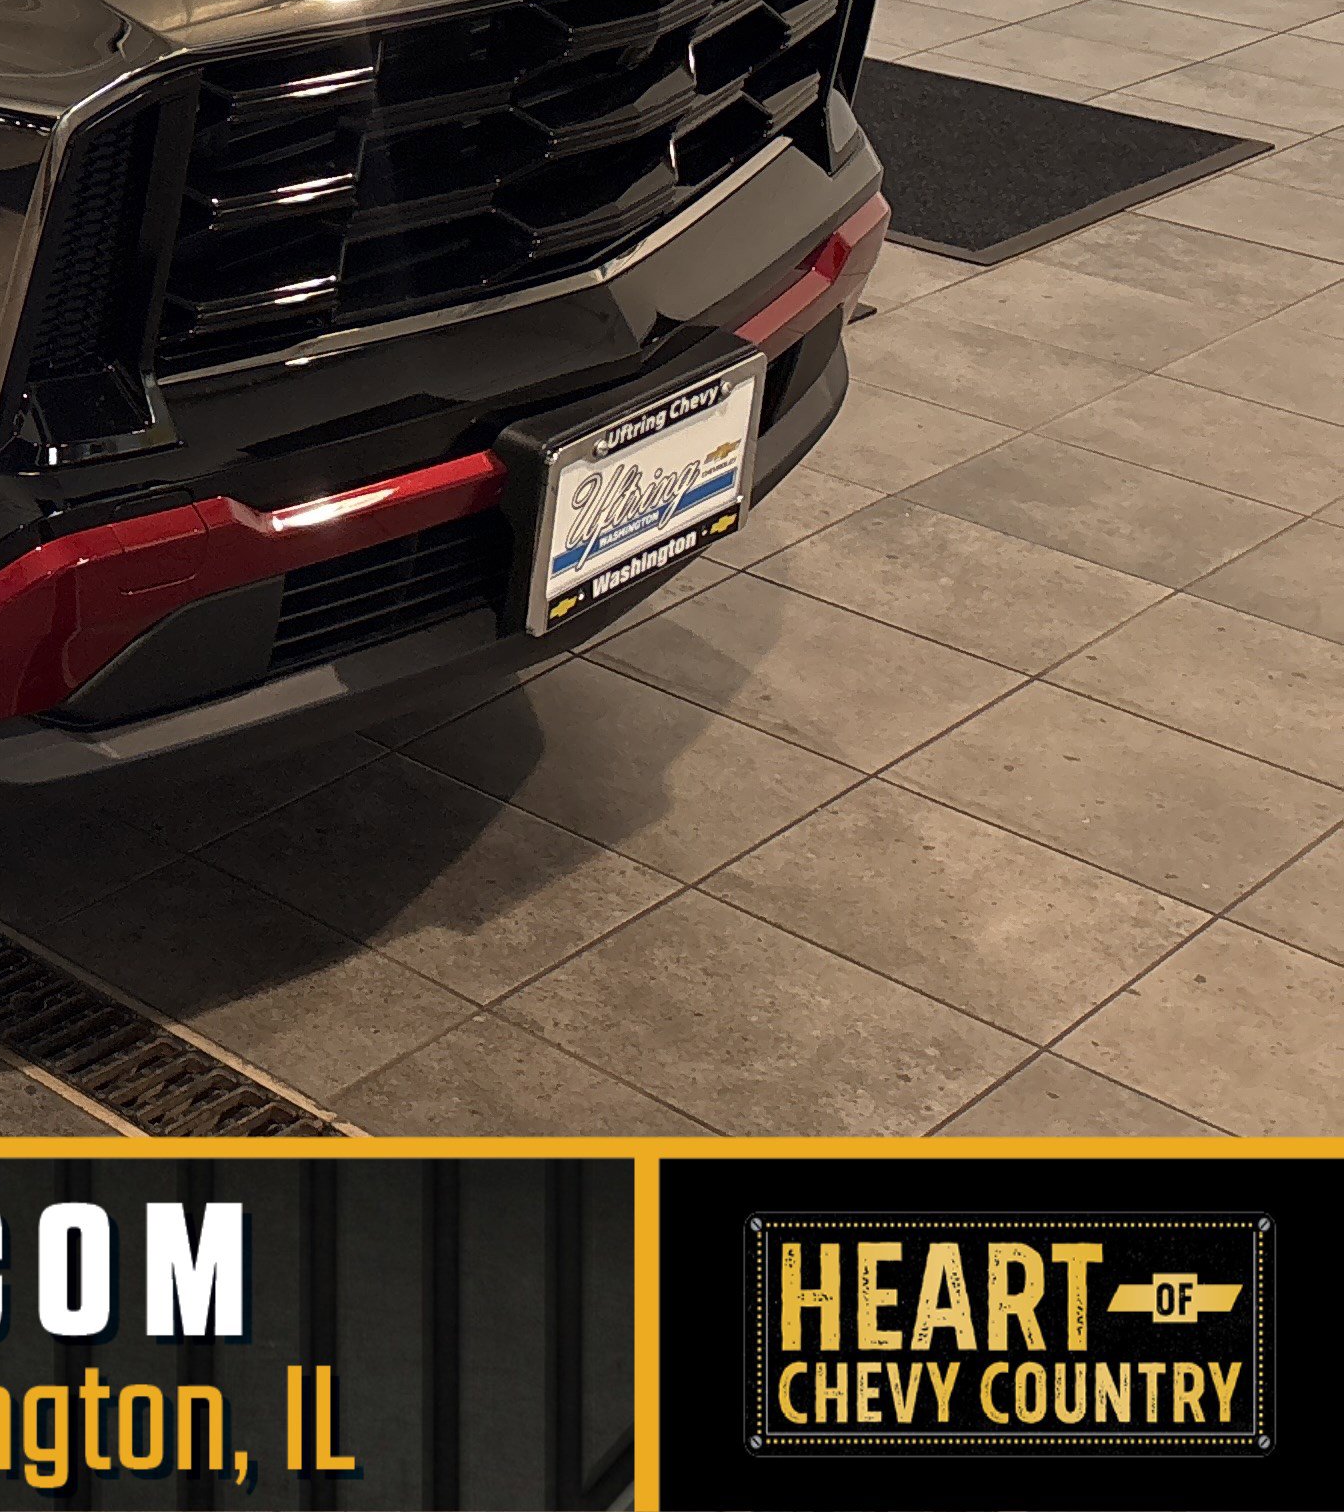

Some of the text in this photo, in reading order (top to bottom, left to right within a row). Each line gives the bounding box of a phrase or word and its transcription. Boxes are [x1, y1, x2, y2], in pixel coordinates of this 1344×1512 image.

[607, 384, 720, 449] Uftring Chevy
[565, 459, 701, 571] Uftring
[599, 510, 660, 548] WASHINGTON
[592, 530, 697, 598] Washington
